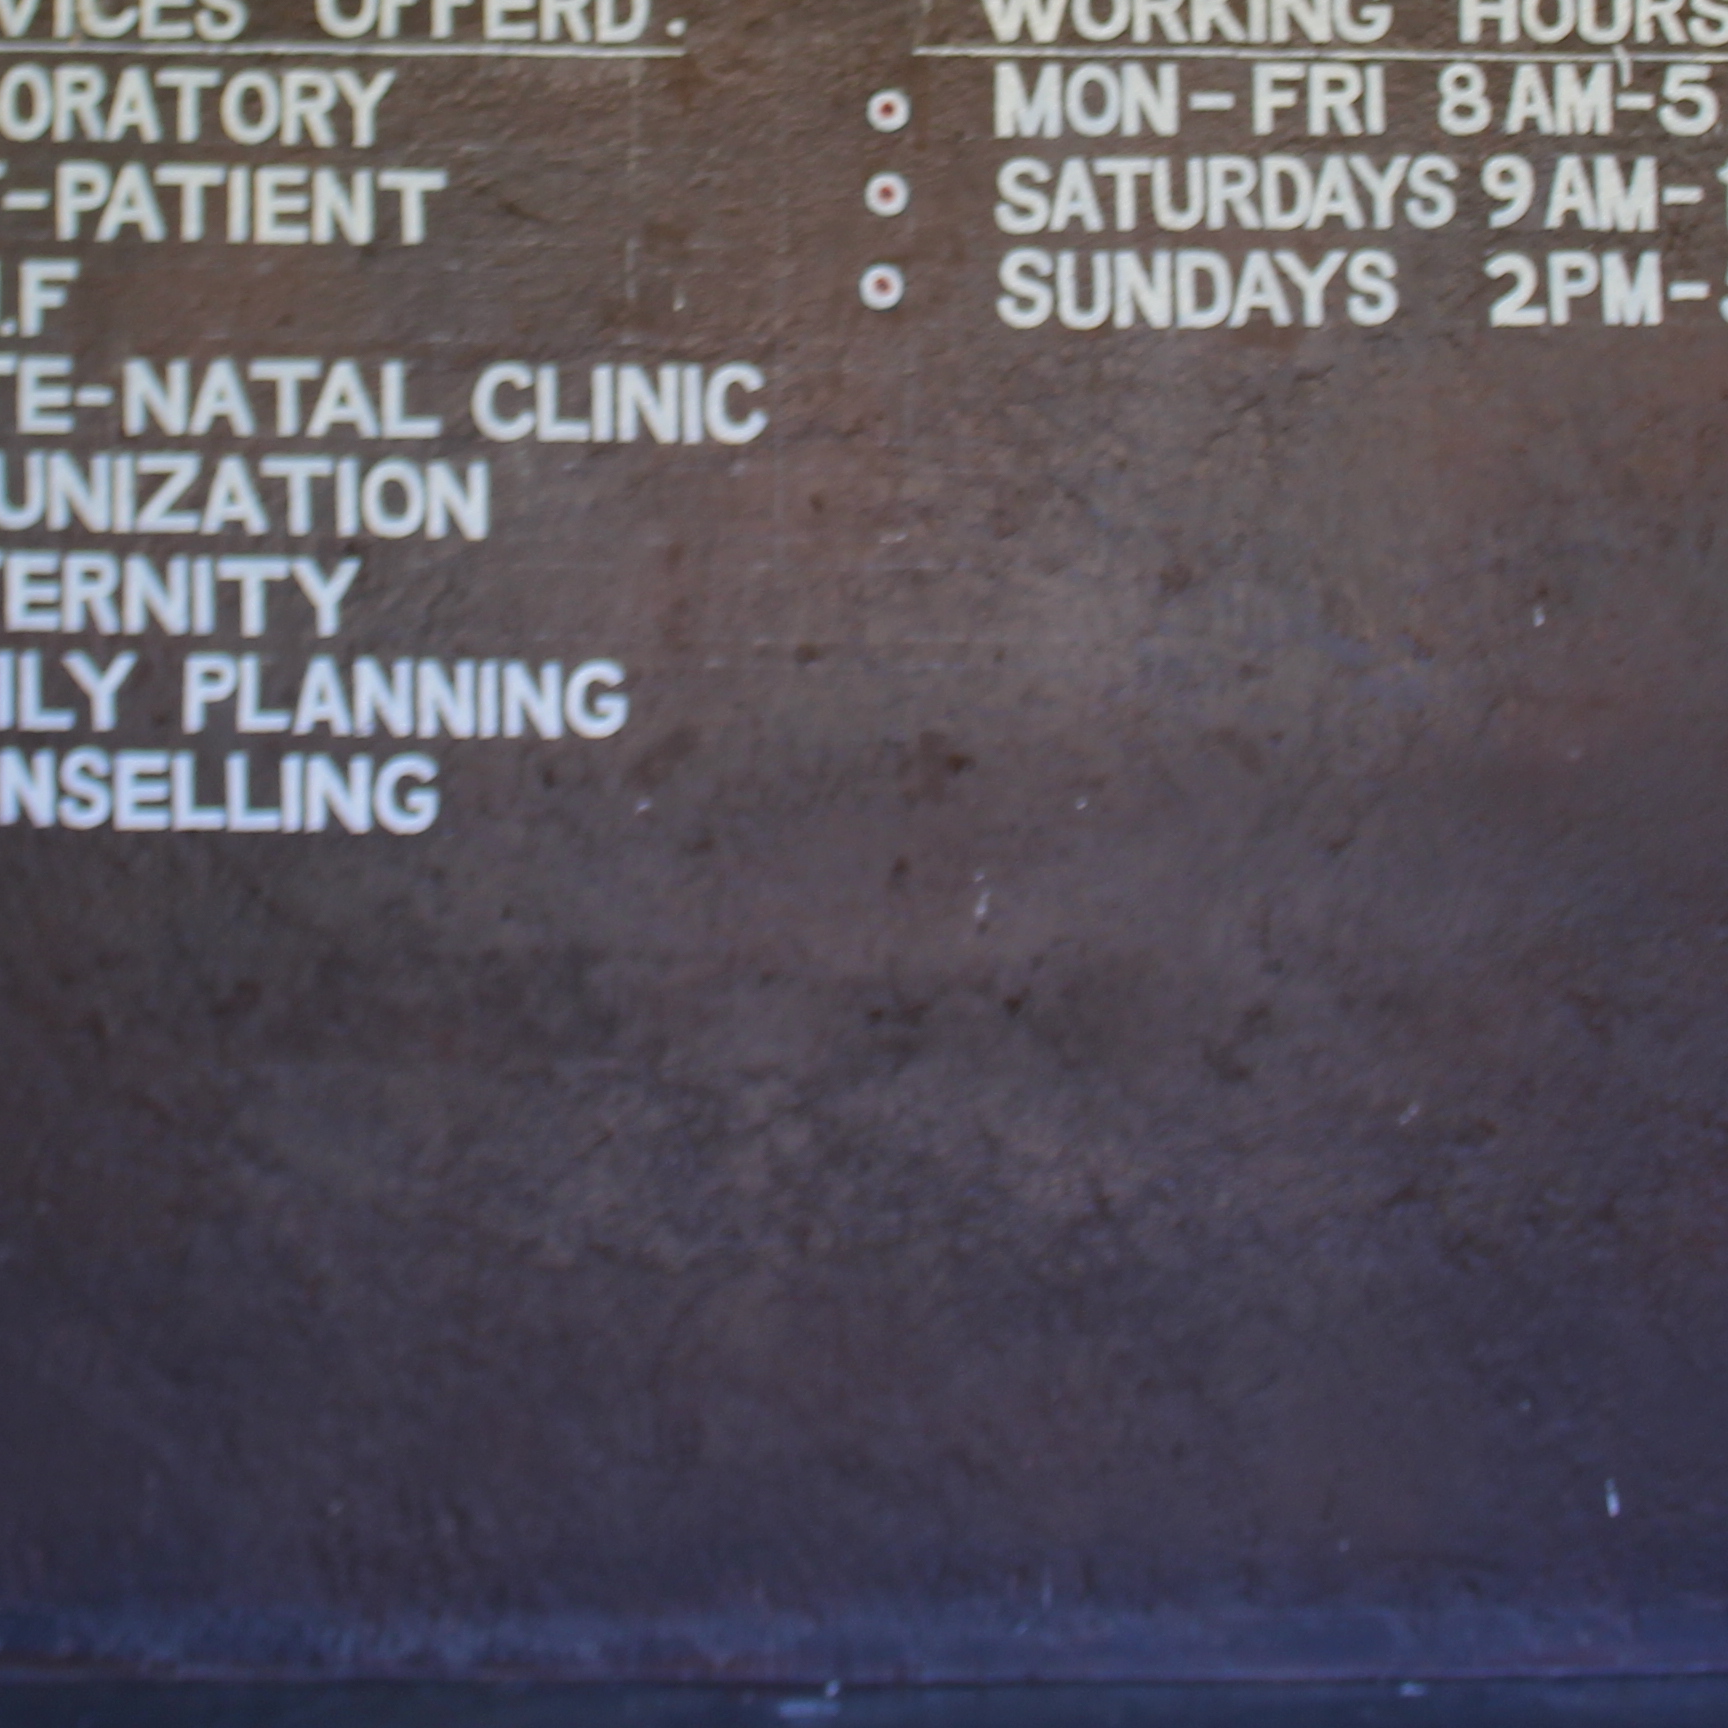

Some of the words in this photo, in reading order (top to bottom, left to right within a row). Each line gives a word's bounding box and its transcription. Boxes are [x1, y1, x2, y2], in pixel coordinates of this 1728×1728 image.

[996, 155, 1457, 233] SATURDAYS
[998, 249, 1397, 328] SUNDAYS
[473, 364, 766, 444] CLINIC
[184, 654, 627, 738] PLANNING
